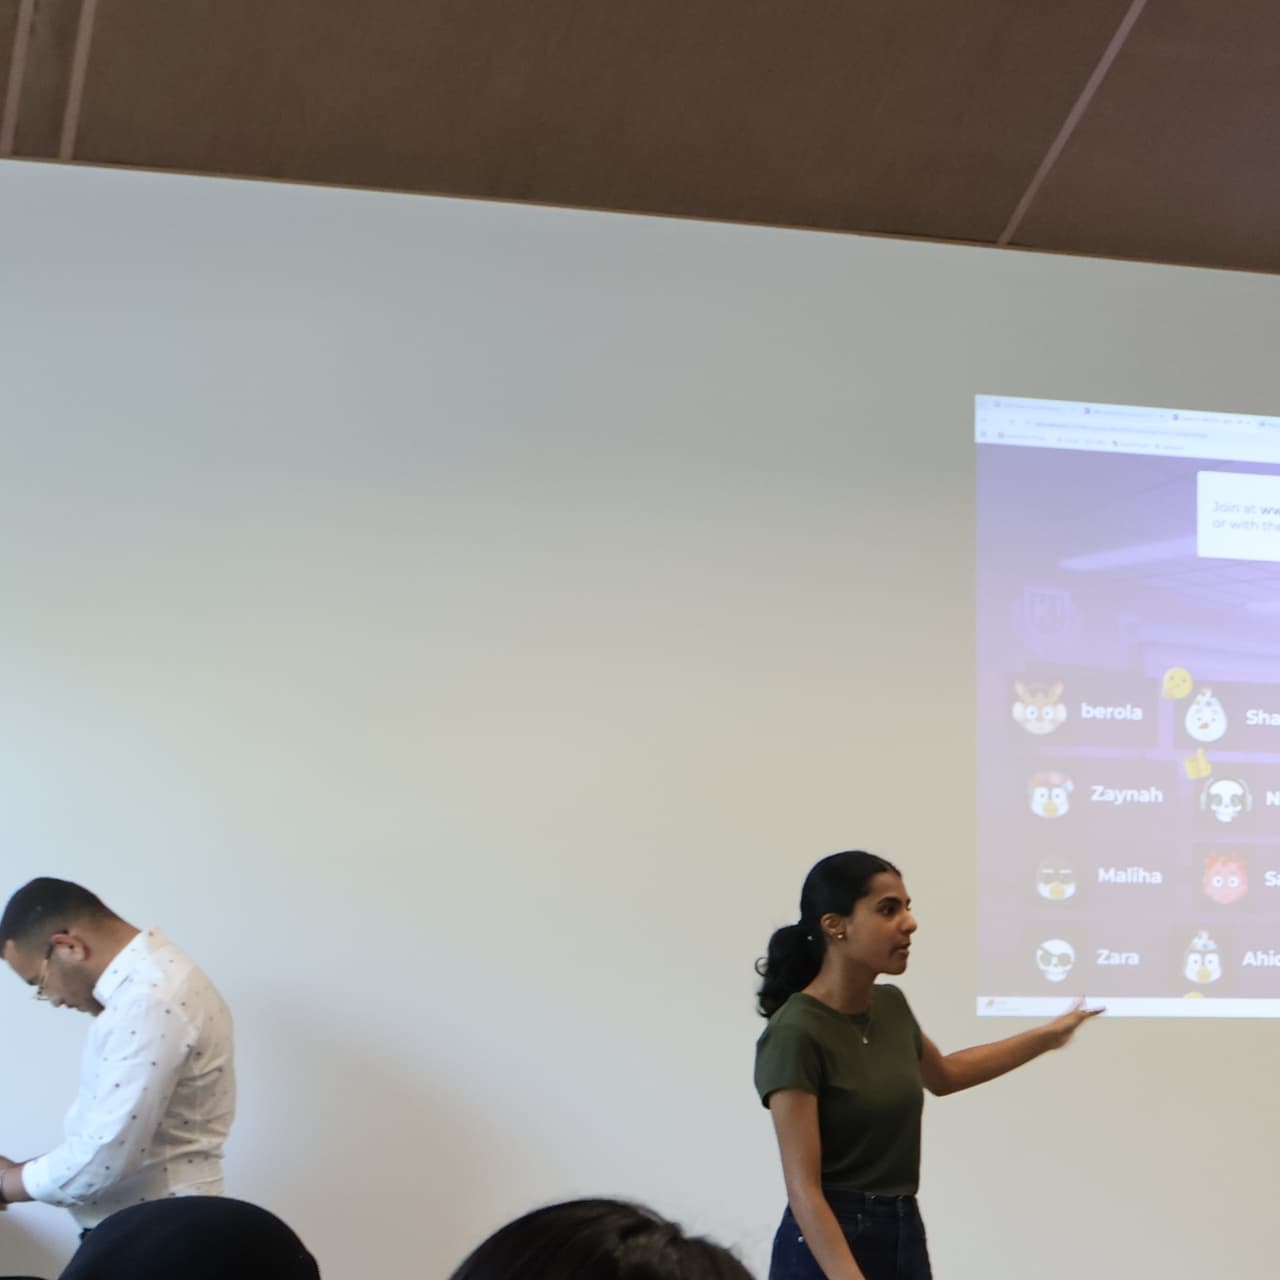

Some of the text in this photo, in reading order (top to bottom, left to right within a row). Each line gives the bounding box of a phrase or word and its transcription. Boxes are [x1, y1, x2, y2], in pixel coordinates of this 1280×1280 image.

[1091, 785, 1163, 805] Zaynah
[1098, 866, 1163, 884] Maliha
[1096, 949, 1140, 965] Zara
